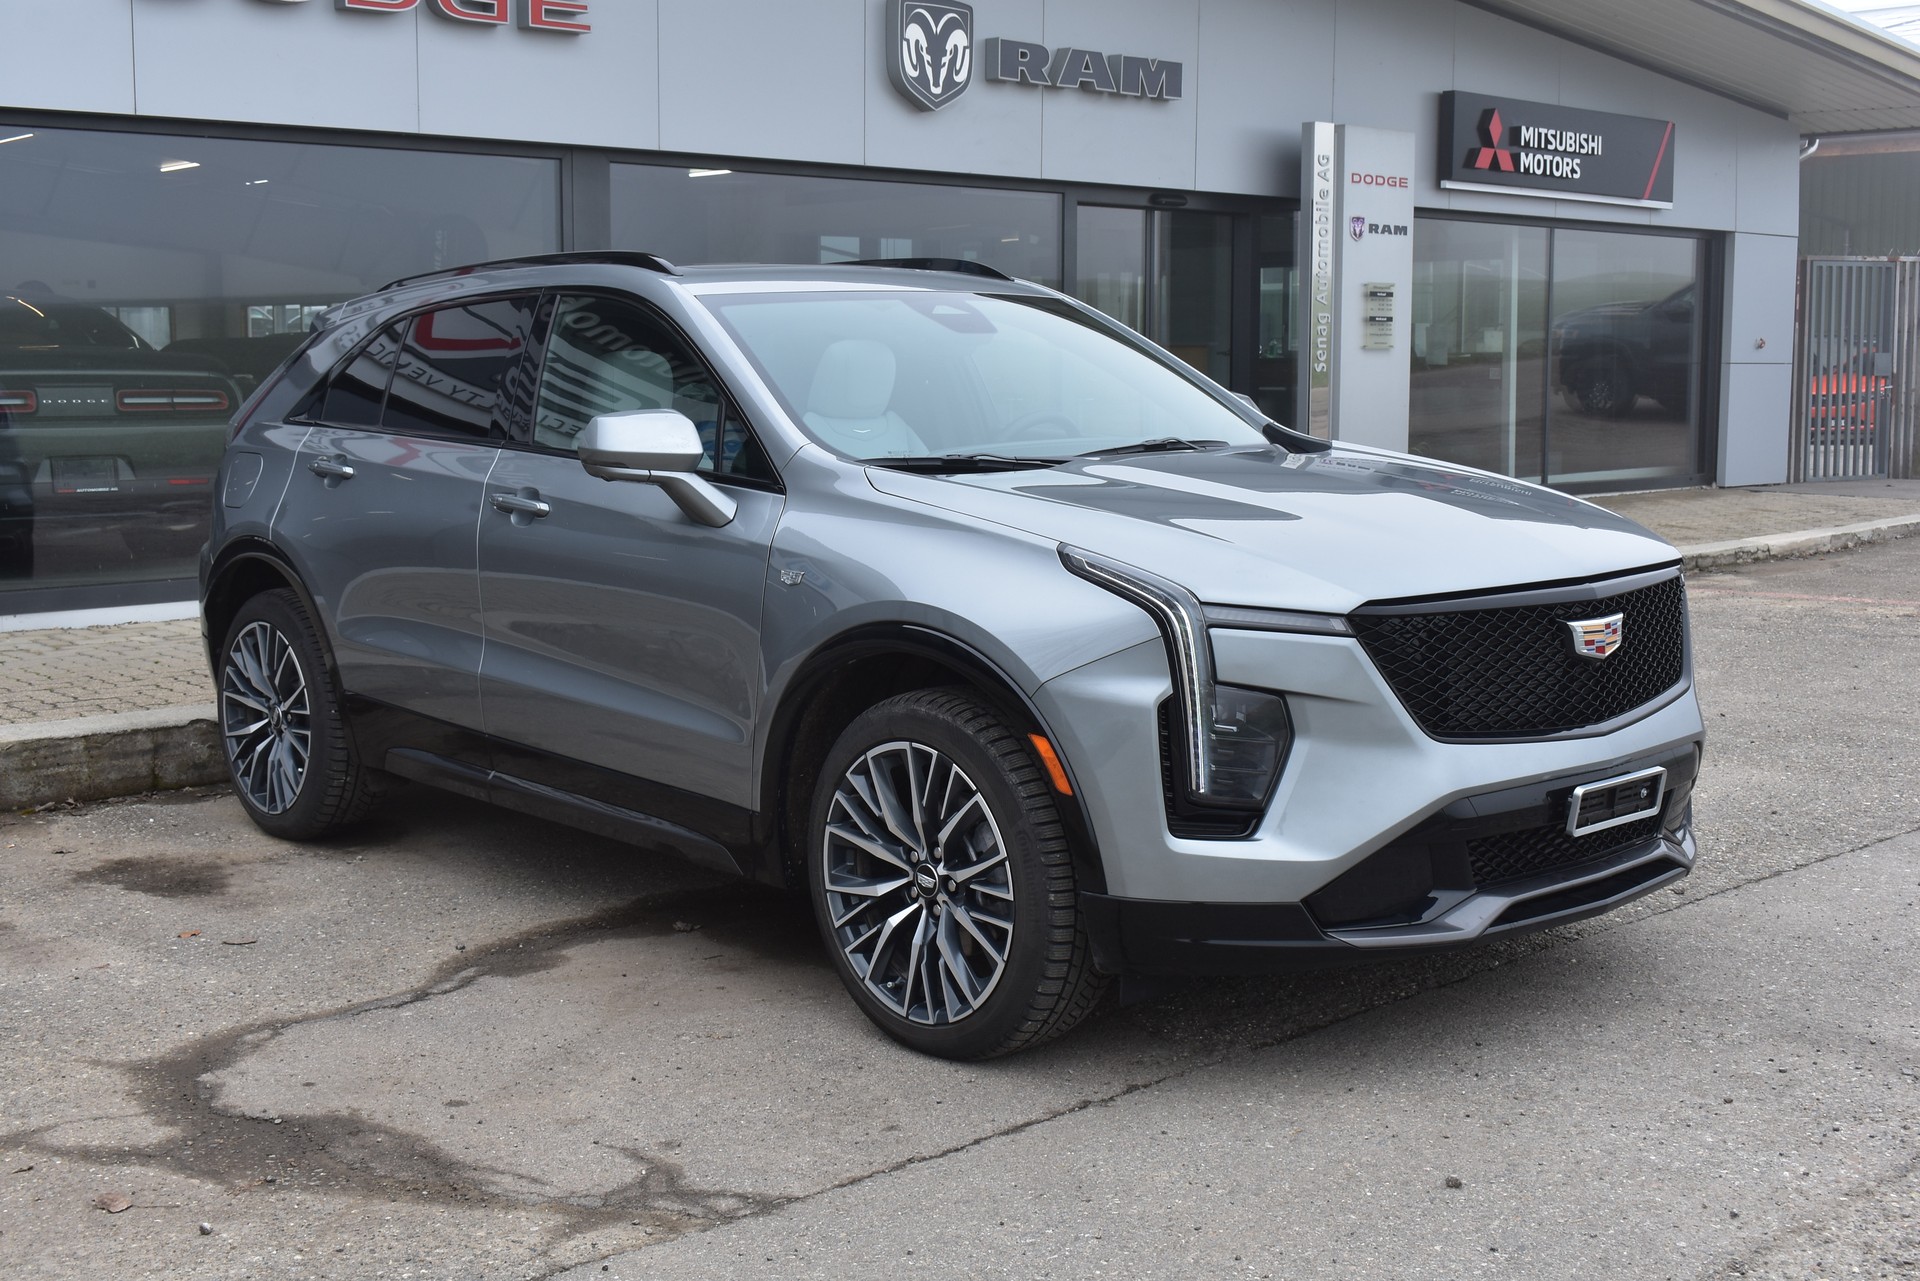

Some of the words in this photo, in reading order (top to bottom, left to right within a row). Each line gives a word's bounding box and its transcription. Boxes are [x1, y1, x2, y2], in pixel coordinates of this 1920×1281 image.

[986, 36, 1184, 101] RAM
[1520, 124, 1603, 156] MITSUBISHI
[1317, 153, 1331, 184] AG
[1350, 172, 1409, 189] DODGE
[1519, 152, 1581, 179] MOTORS
[1368, 223, 1408, 236] RAM
[1315, 188, 1330, 305] Automobile
[1314, 313, 1330, 372] Senag
